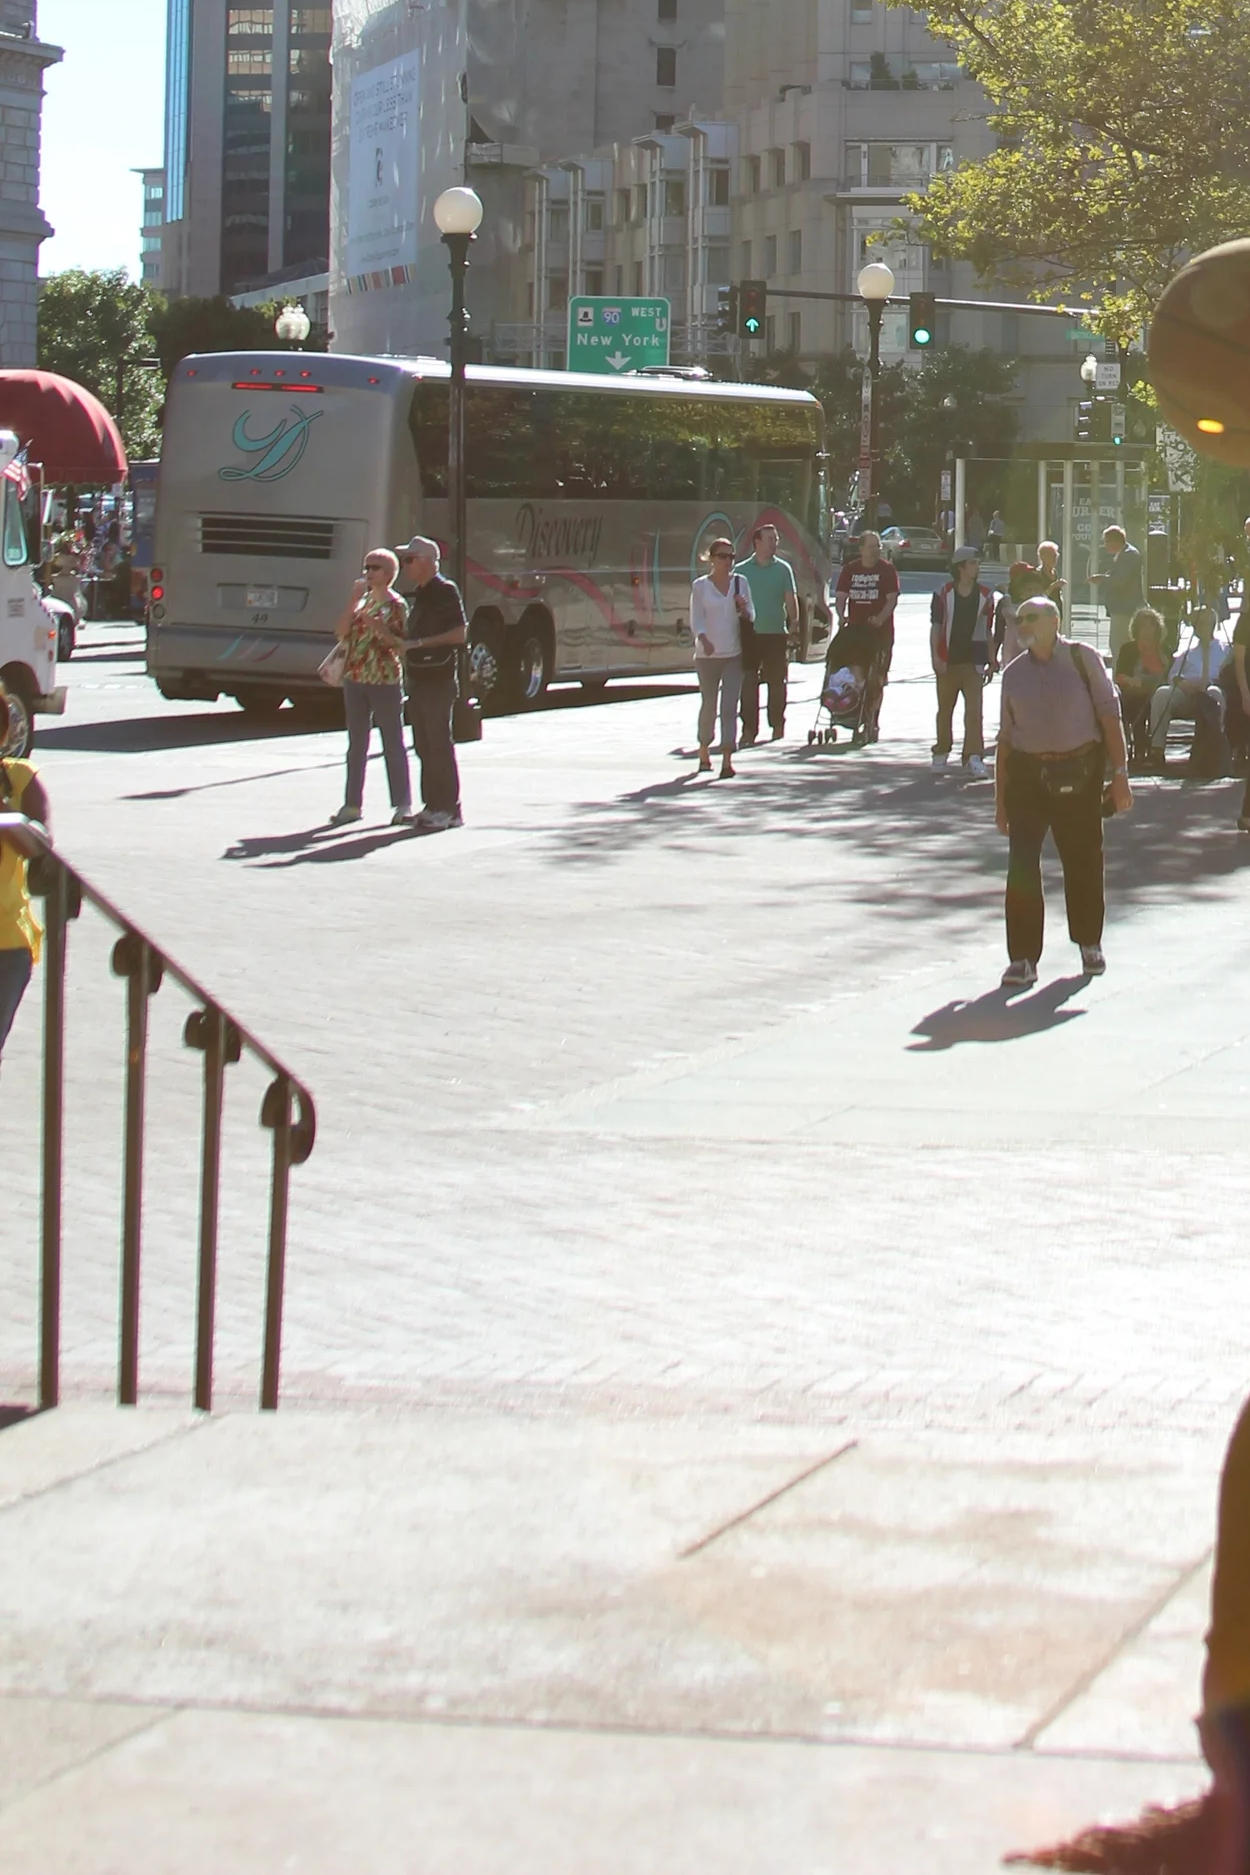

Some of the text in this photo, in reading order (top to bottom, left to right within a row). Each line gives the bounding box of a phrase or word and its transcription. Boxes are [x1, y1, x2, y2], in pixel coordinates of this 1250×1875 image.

[603, 307, 662, 323] 90 WEST
[576, 333, 660, 346] New York
[515, 502, 604, 568] Discovery
